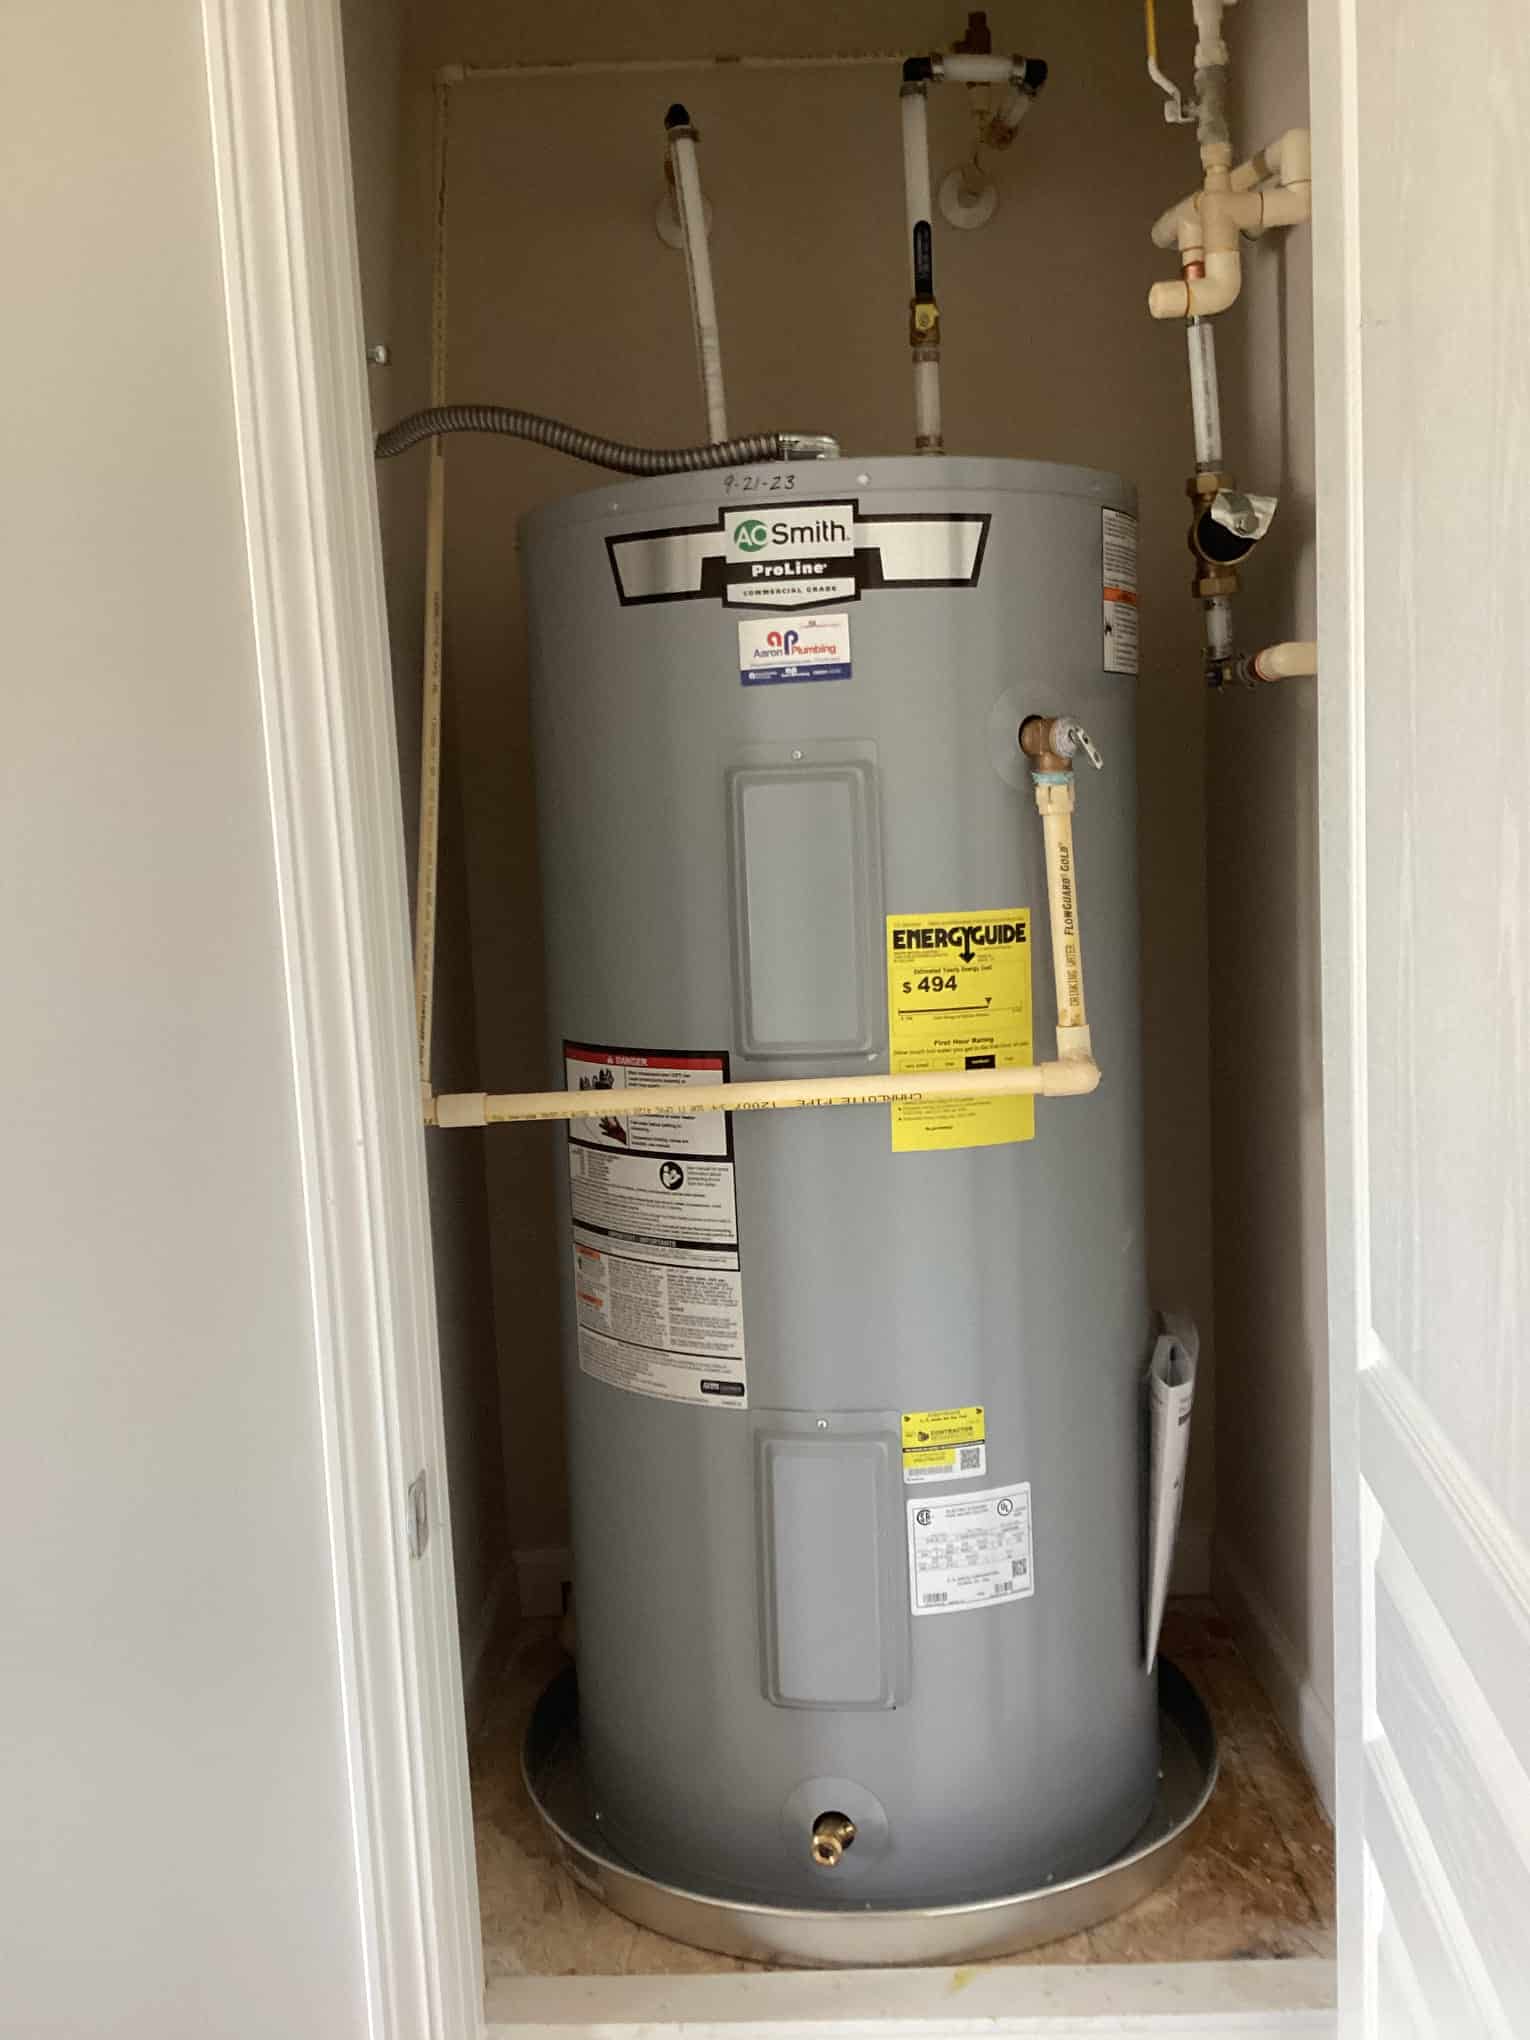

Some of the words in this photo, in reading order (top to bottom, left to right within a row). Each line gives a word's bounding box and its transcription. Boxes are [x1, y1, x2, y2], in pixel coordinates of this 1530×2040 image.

[724, 474, 795, 495] 9-21-23
[771, 520, 846, 544] Smith
[743, 587, 801, 596] COMMERCIAL
[806, 585, 836, 593] GRADE
[753, 648, 784, 658] Aaron
[791, 643, 836, 656] Plumbing
[893, 923, 1026, 951] ENERGYGUIDE
[917, 975, 958, 993] 494
